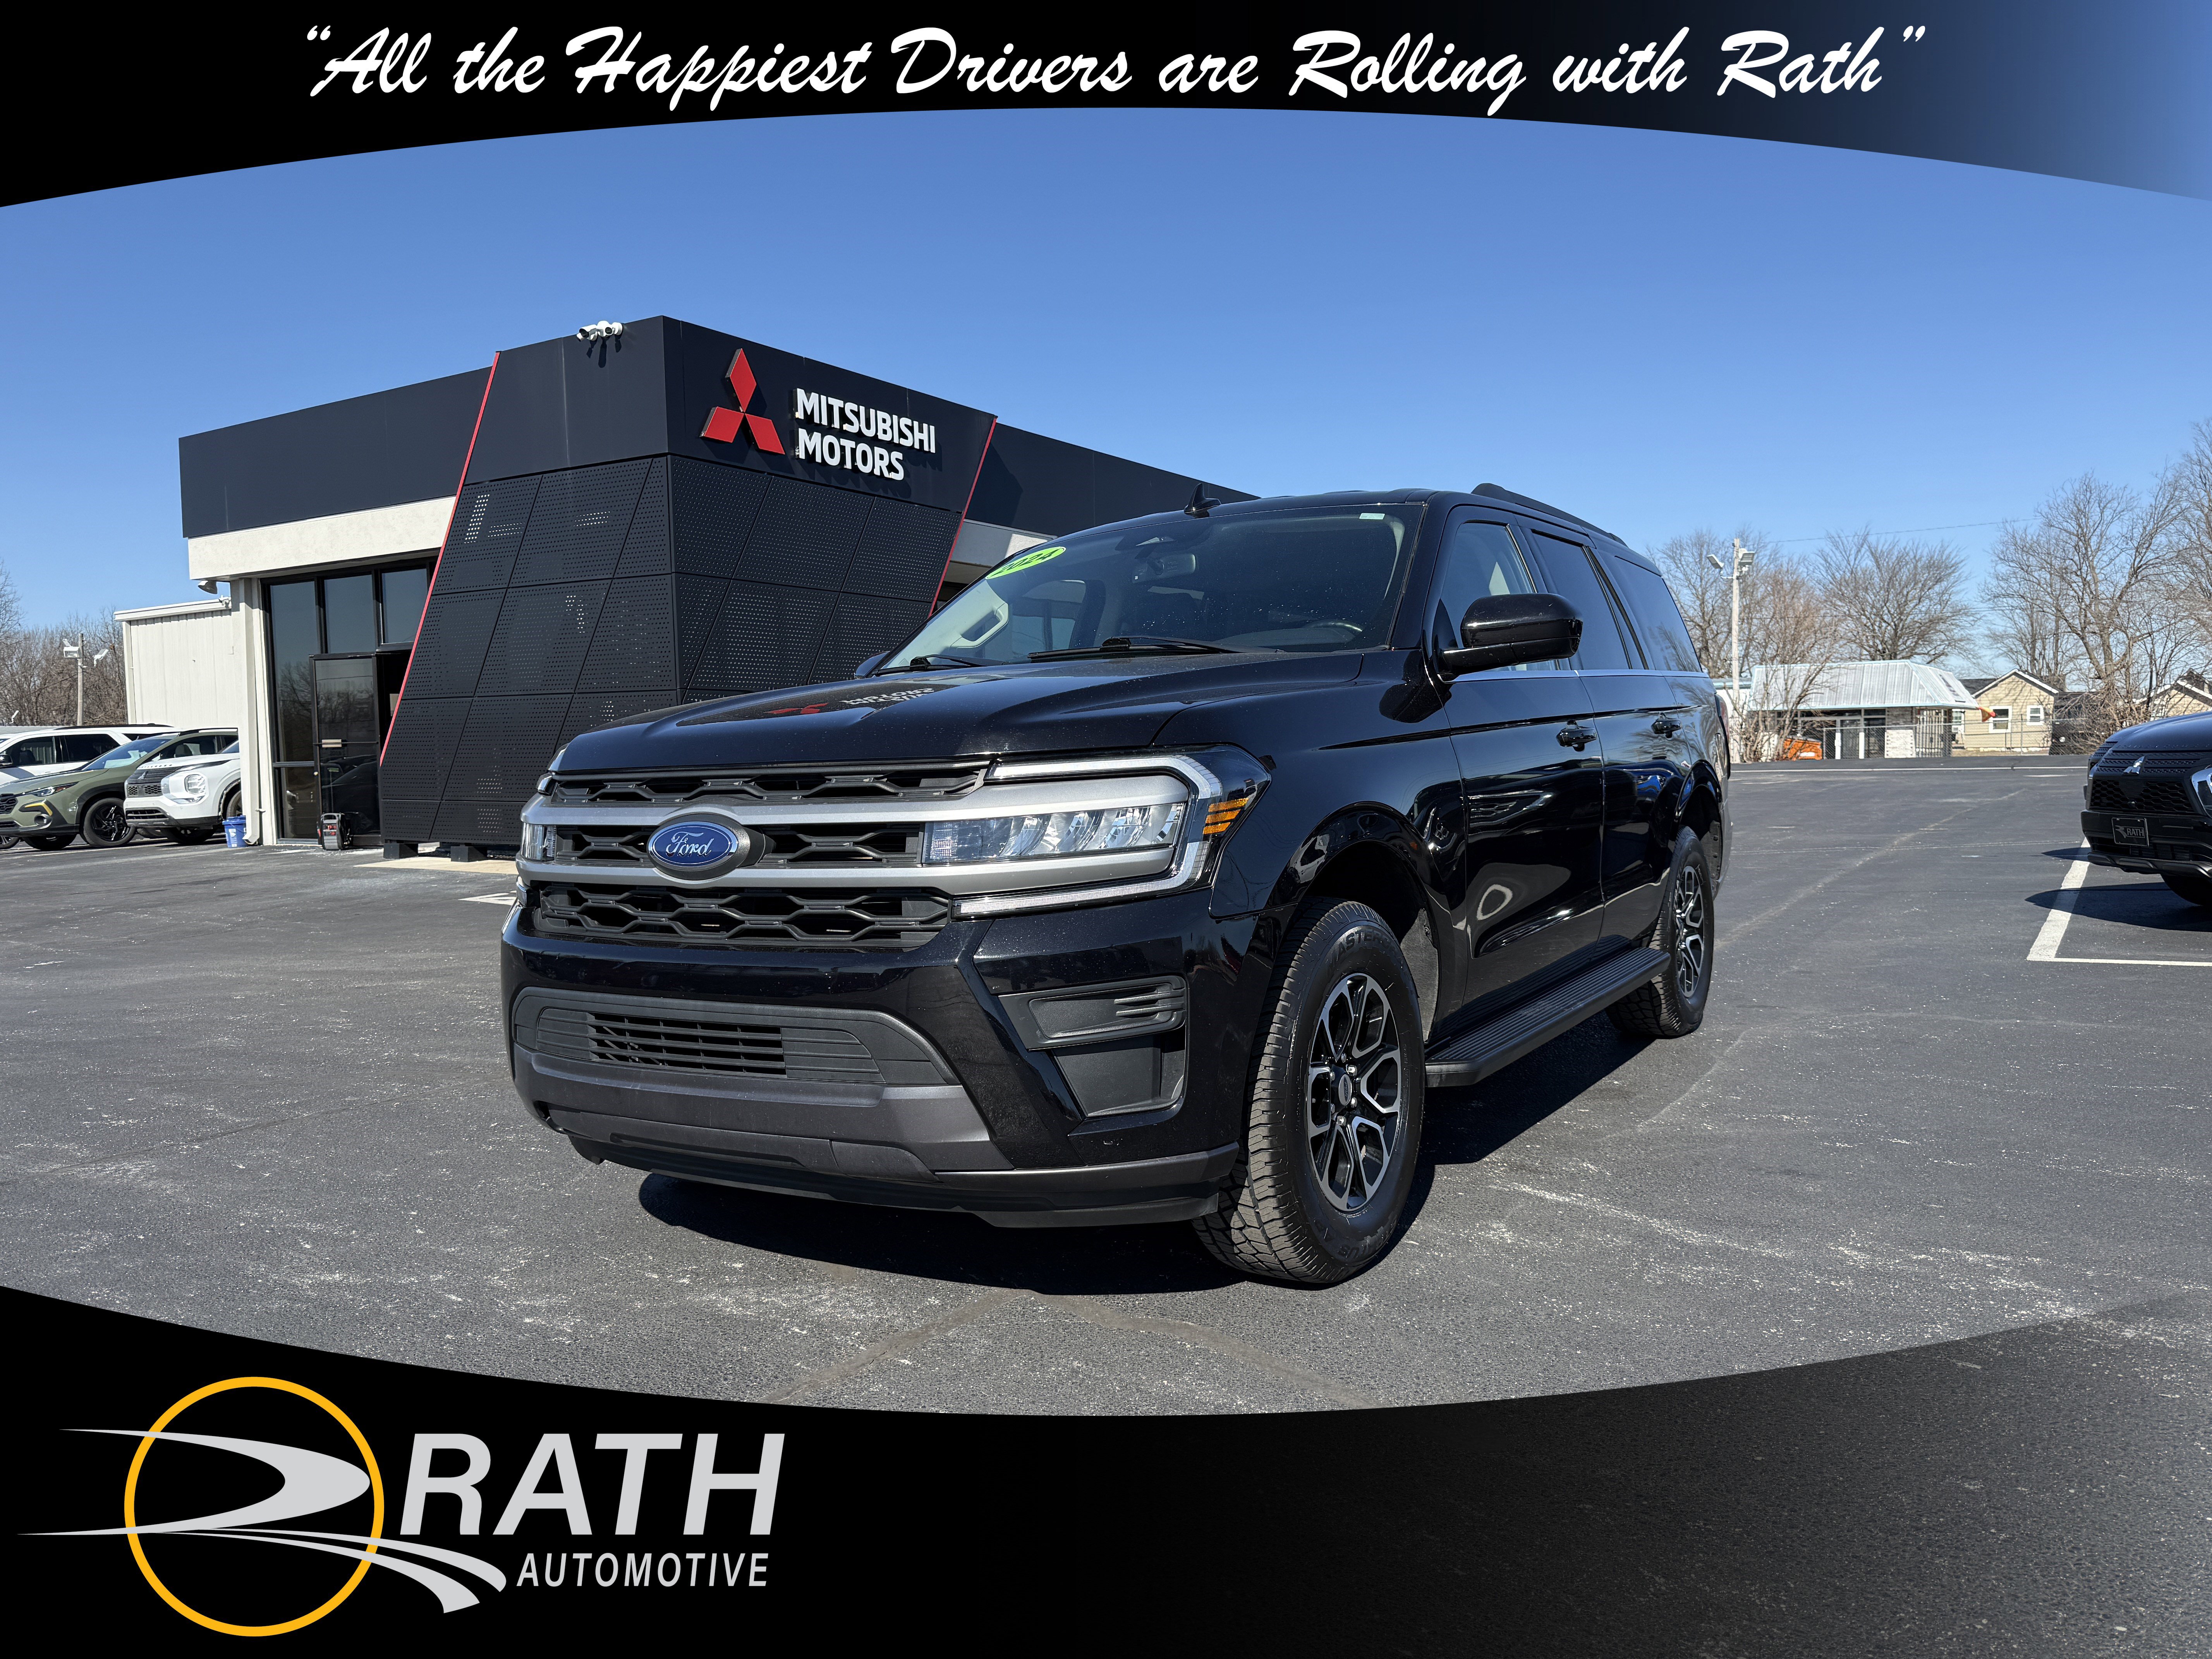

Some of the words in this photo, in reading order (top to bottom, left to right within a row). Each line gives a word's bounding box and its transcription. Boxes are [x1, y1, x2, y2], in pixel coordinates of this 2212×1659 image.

[795, 388, 936, 453] MITSUBISHI
[796, 428, 904, 481] MOTORS
[991, 549, 1060, 577] 2024
[666, 831, 714, 857] Ford
[2127, 828, 2144, 836] RATH
